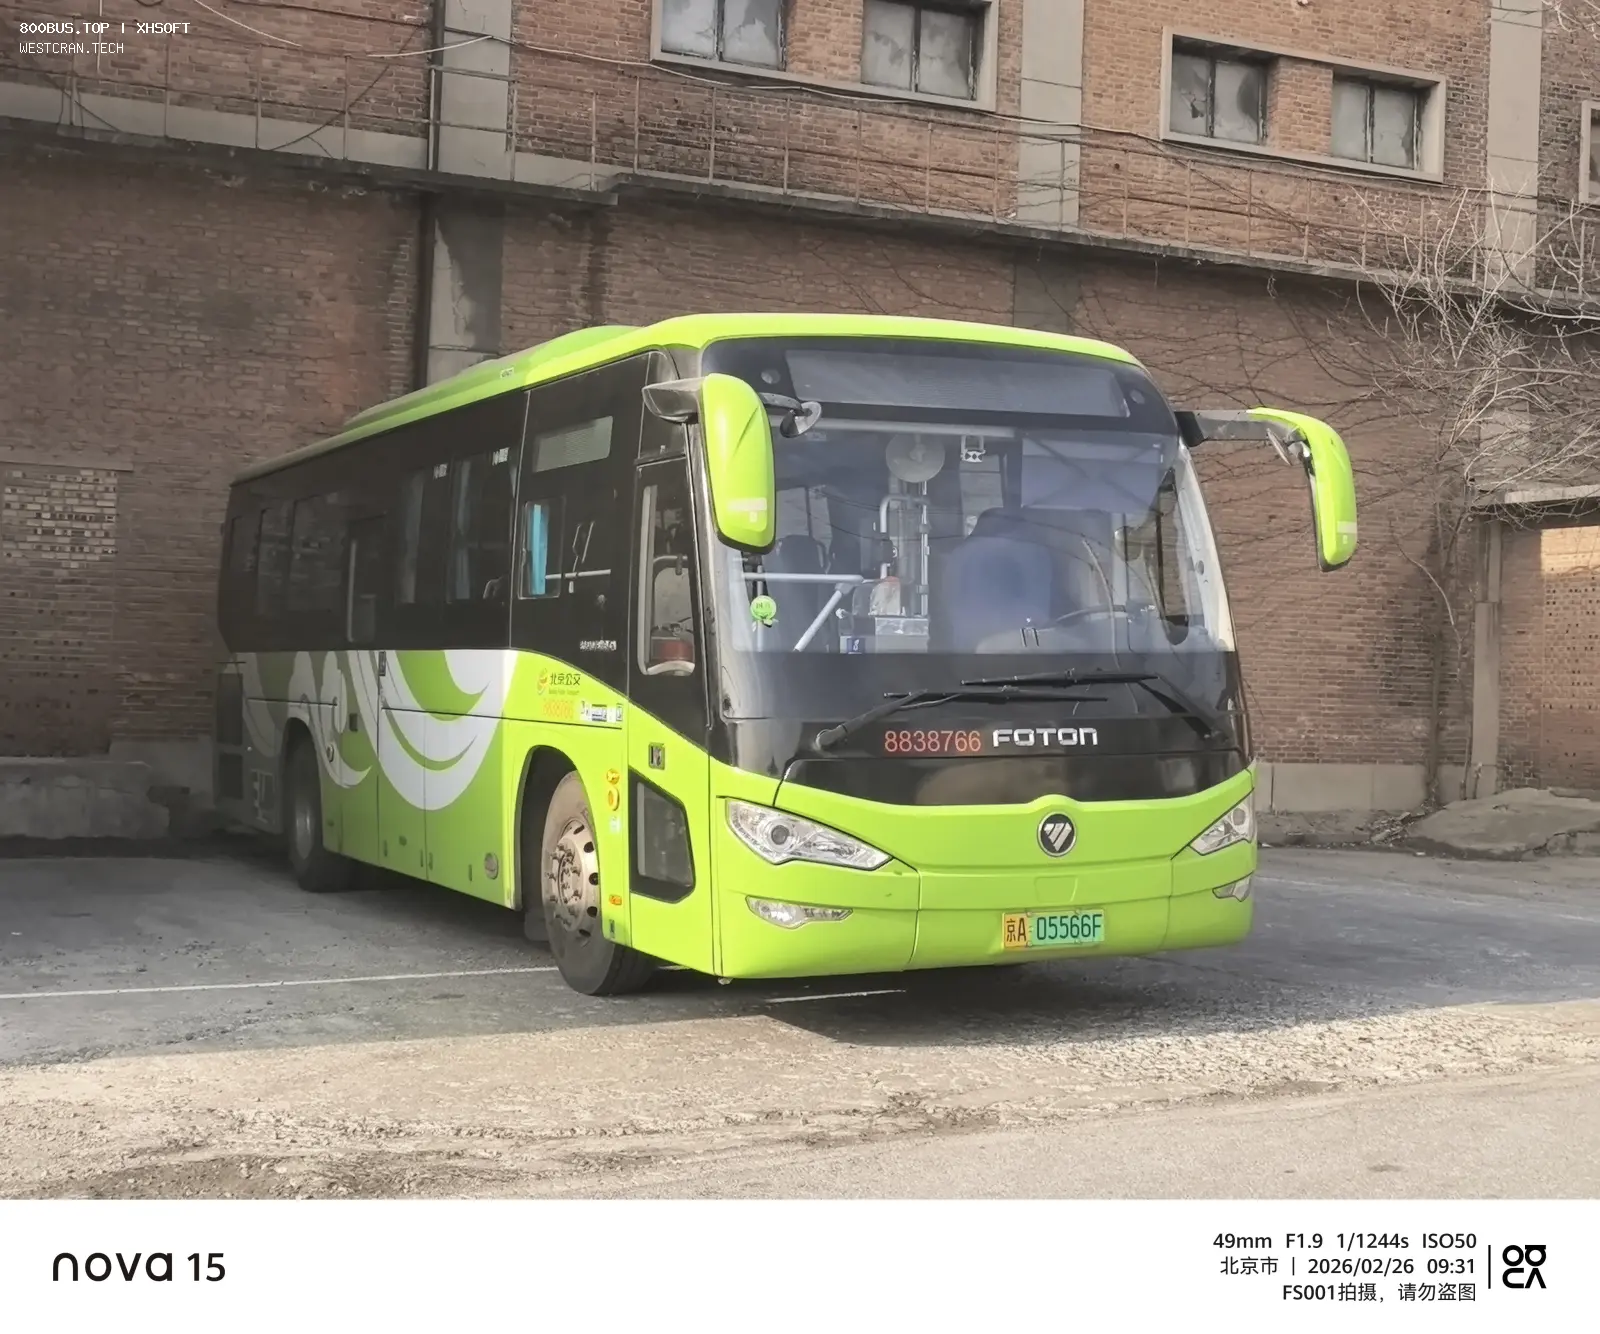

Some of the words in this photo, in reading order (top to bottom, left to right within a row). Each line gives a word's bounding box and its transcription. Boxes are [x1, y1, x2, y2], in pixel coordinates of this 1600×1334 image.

[550, 673, 581, 686] 北京公交
[884, 730, 982, 752] 8838766
[992, 727, 1098, 747] FOTON
